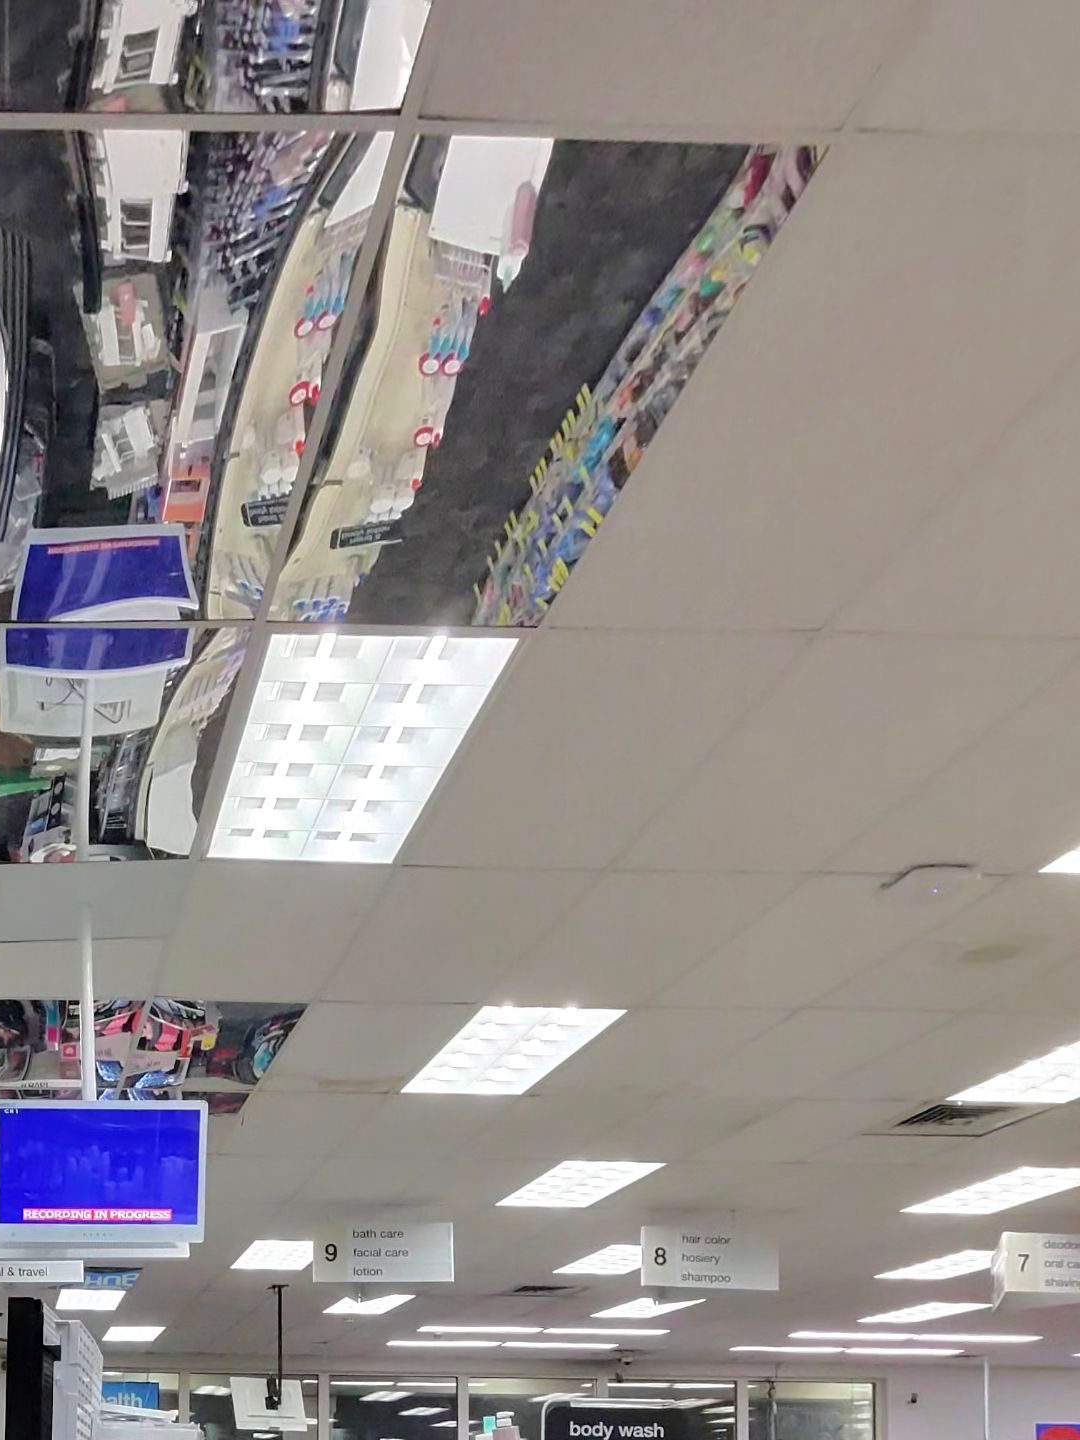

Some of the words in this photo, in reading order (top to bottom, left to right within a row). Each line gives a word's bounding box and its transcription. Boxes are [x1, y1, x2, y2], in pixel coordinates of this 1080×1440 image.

[23, 1209, 91, 1220] RECORDING
[94, 1209, 108, 1220] IN
[110, 1209, 172, 1220] PROGRESS
[352, 1229, 377, 1239] bath
[380, 1231, 404, 1239] care
[682, 1234, 701, 1245] hair
[704, 1235, 732, 1245] color
[325, 1243, 338, 1262] 9
[353, 1248, 382, 1258] facial
[385, 1250, 409, 1258] care
[654, 1247, 667, 1266] 8
[681, 1252, 721, 1266] hosiery
[1018, 1254, 1030, 1272] 7
[7, 1268, 15, 1277] &
[18, 1267, 49, 1277] travel
[353, 1266, 383, 1276] lotion
[681, 1271, 732, 1284] shampoo
[569, 1421, 614, 1440] body
[619, 1423, 665, 1438] wash
